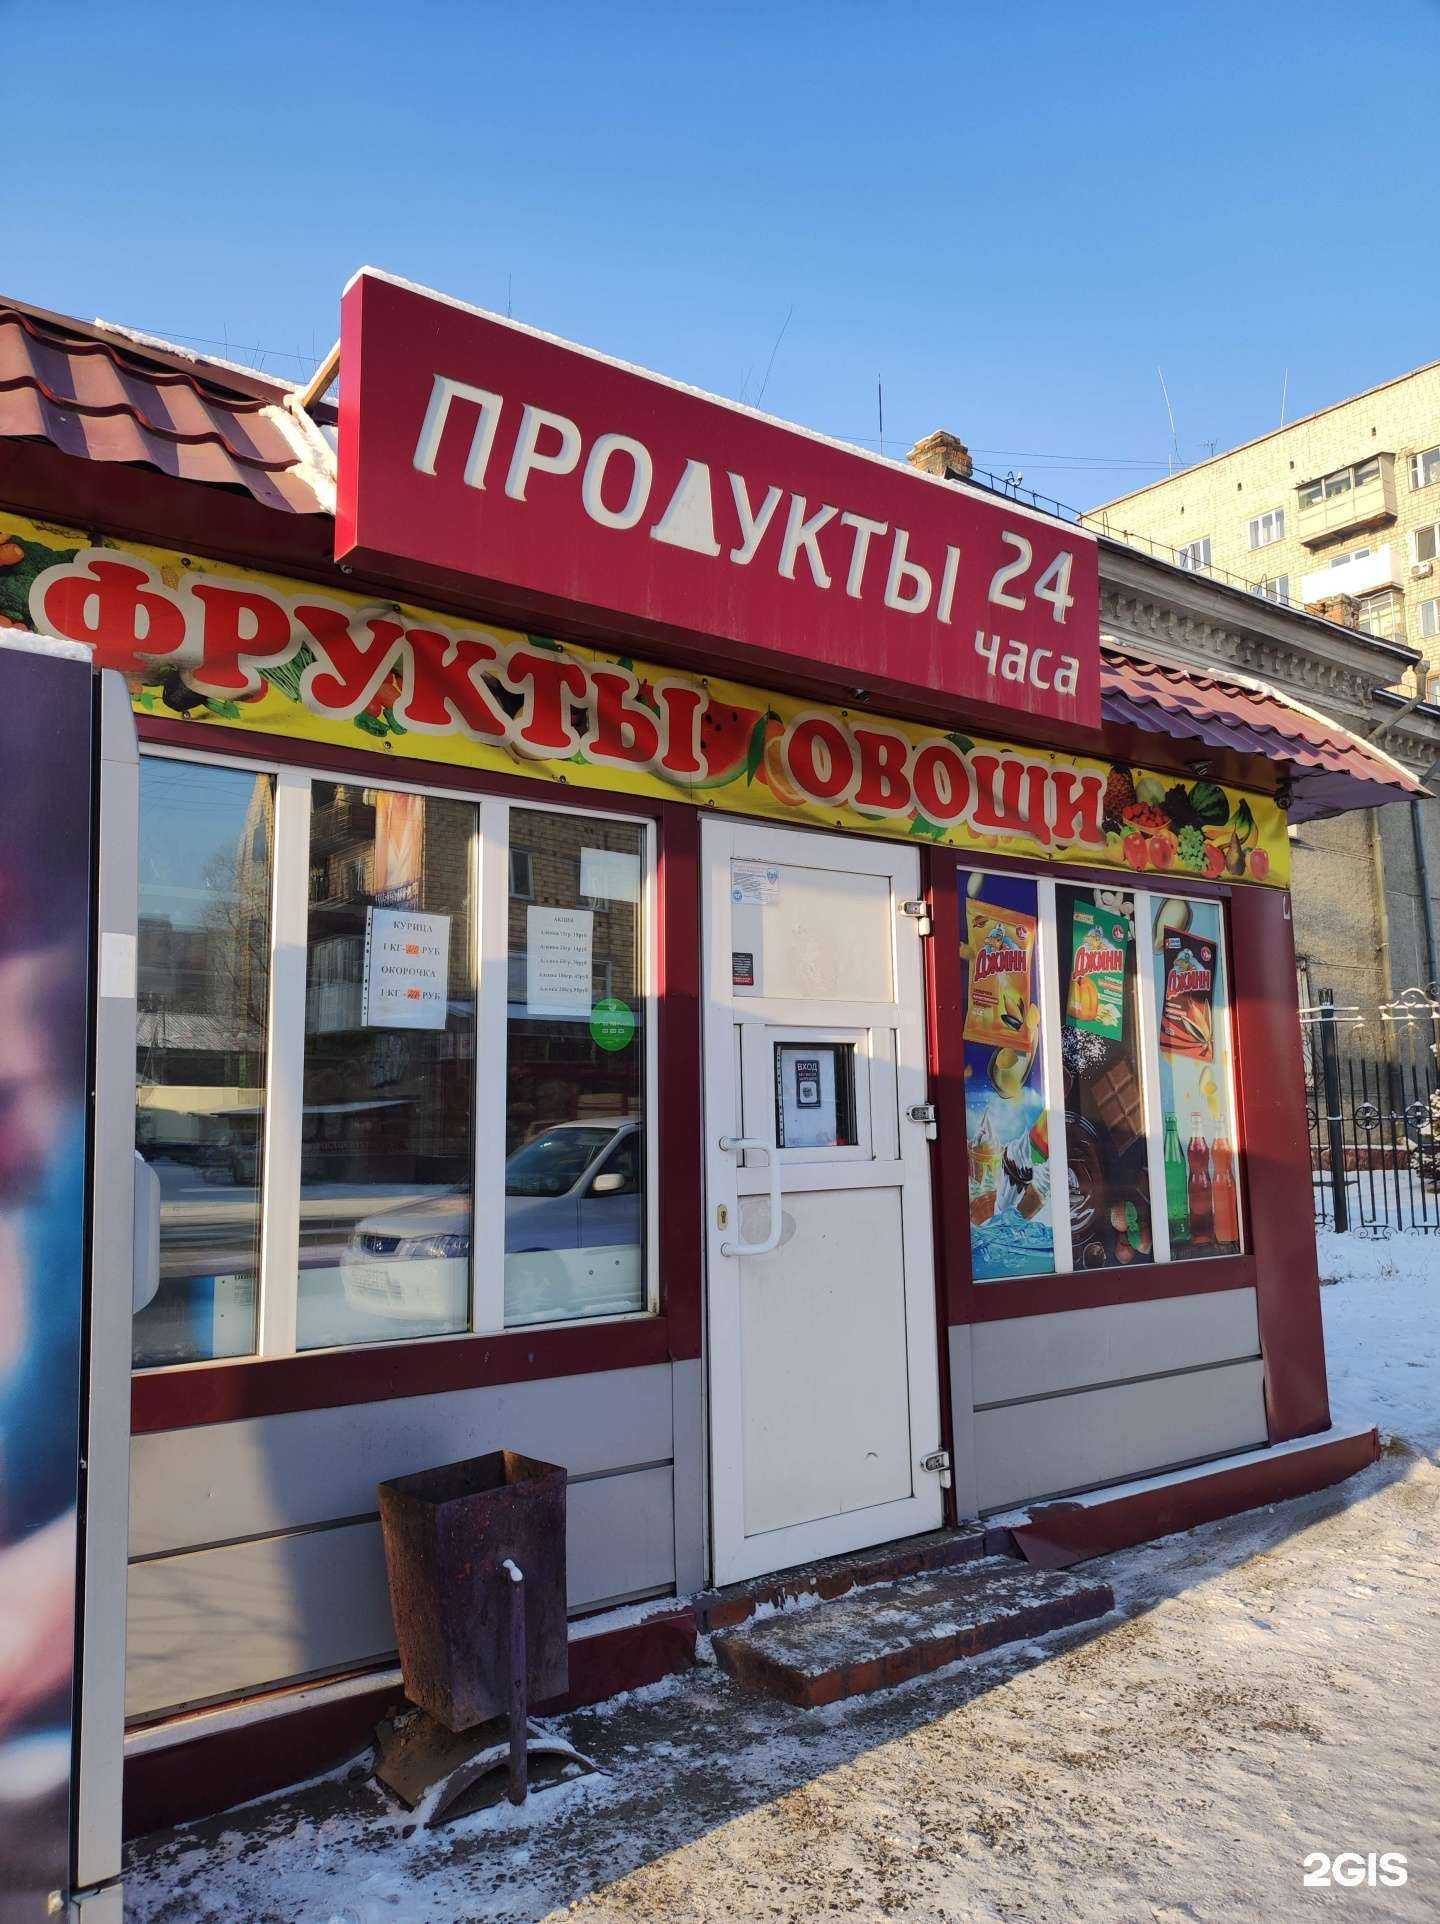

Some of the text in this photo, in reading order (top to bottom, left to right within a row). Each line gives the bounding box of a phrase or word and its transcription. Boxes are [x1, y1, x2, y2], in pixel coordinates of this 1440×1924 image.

[412, 373, 1075, 624] ПРОДУКТЫ 24
[974, 629, 1080, 697] часа
[41, 559, 1104, 847] ФРУКТЫ ОВОЩИ
[393, 920, 434, 934] КУРИЦА
[381, 966, 436, 978] ОКОРОЧКА
[974, 948, 1028, 982] ДЖИНН
[1072, 944, 1124, 980] ДЖИНН
[1166, 969, 1212, 1000] ДЖИНН
[797, 1062, 818, 1072] ВХОД
